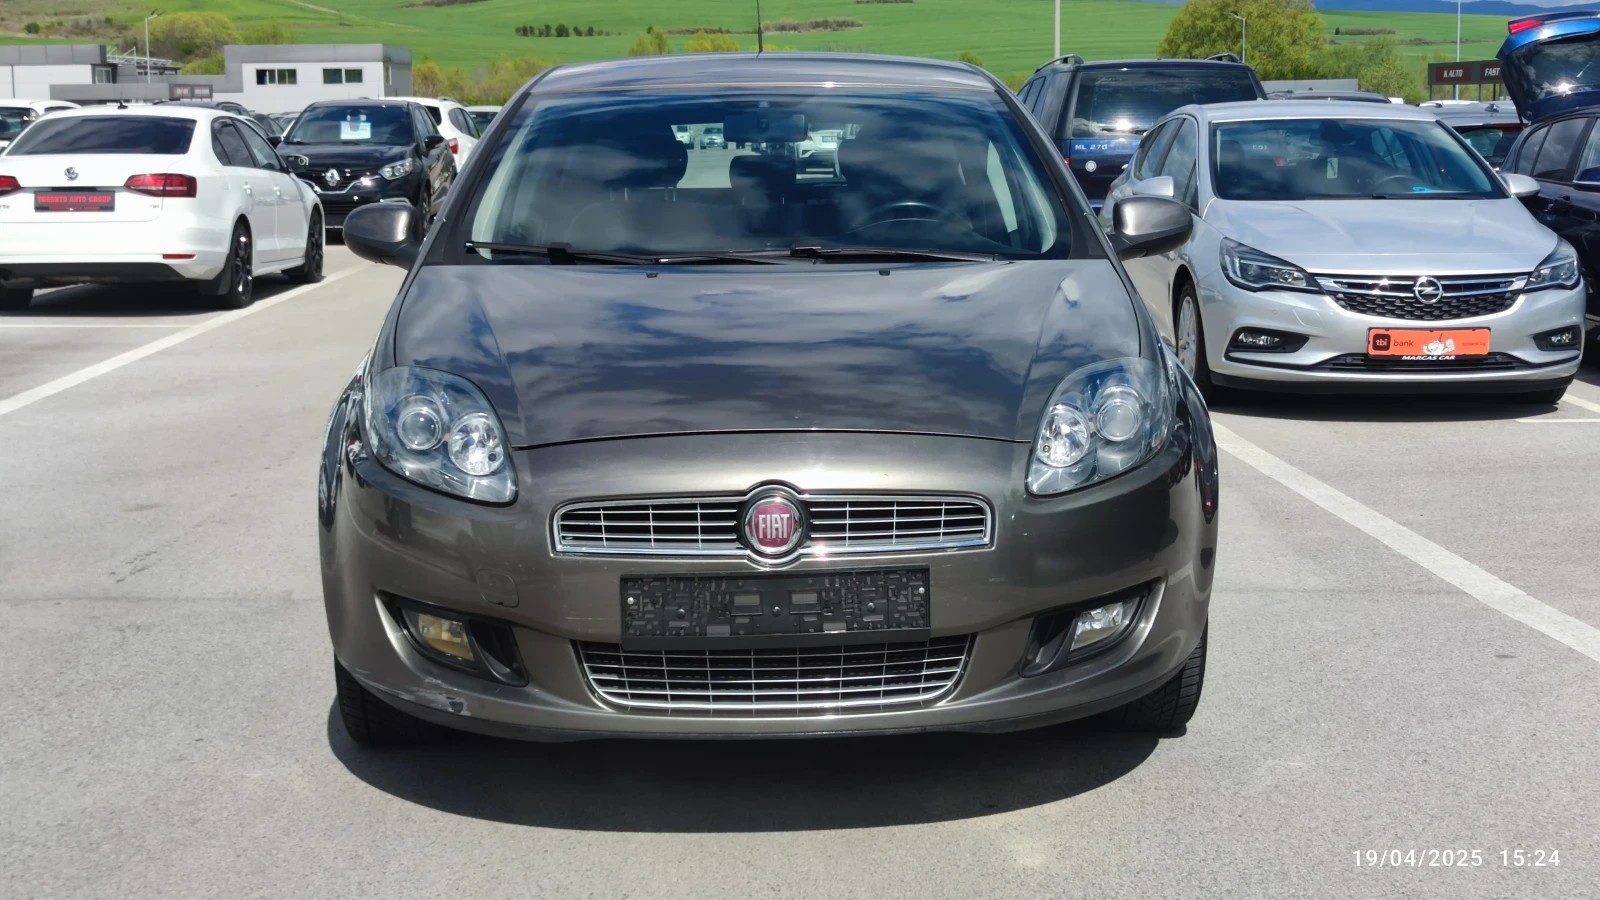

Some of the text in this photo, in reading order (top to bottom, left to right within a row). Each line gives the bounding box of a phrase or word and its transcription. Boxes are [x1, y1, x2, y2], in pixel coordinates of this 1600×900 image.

[1448, 69, 1463, 77] AUTO
[1484, 68, 1501, 76] FAST
[758, 514, 790, 539] FIAT
